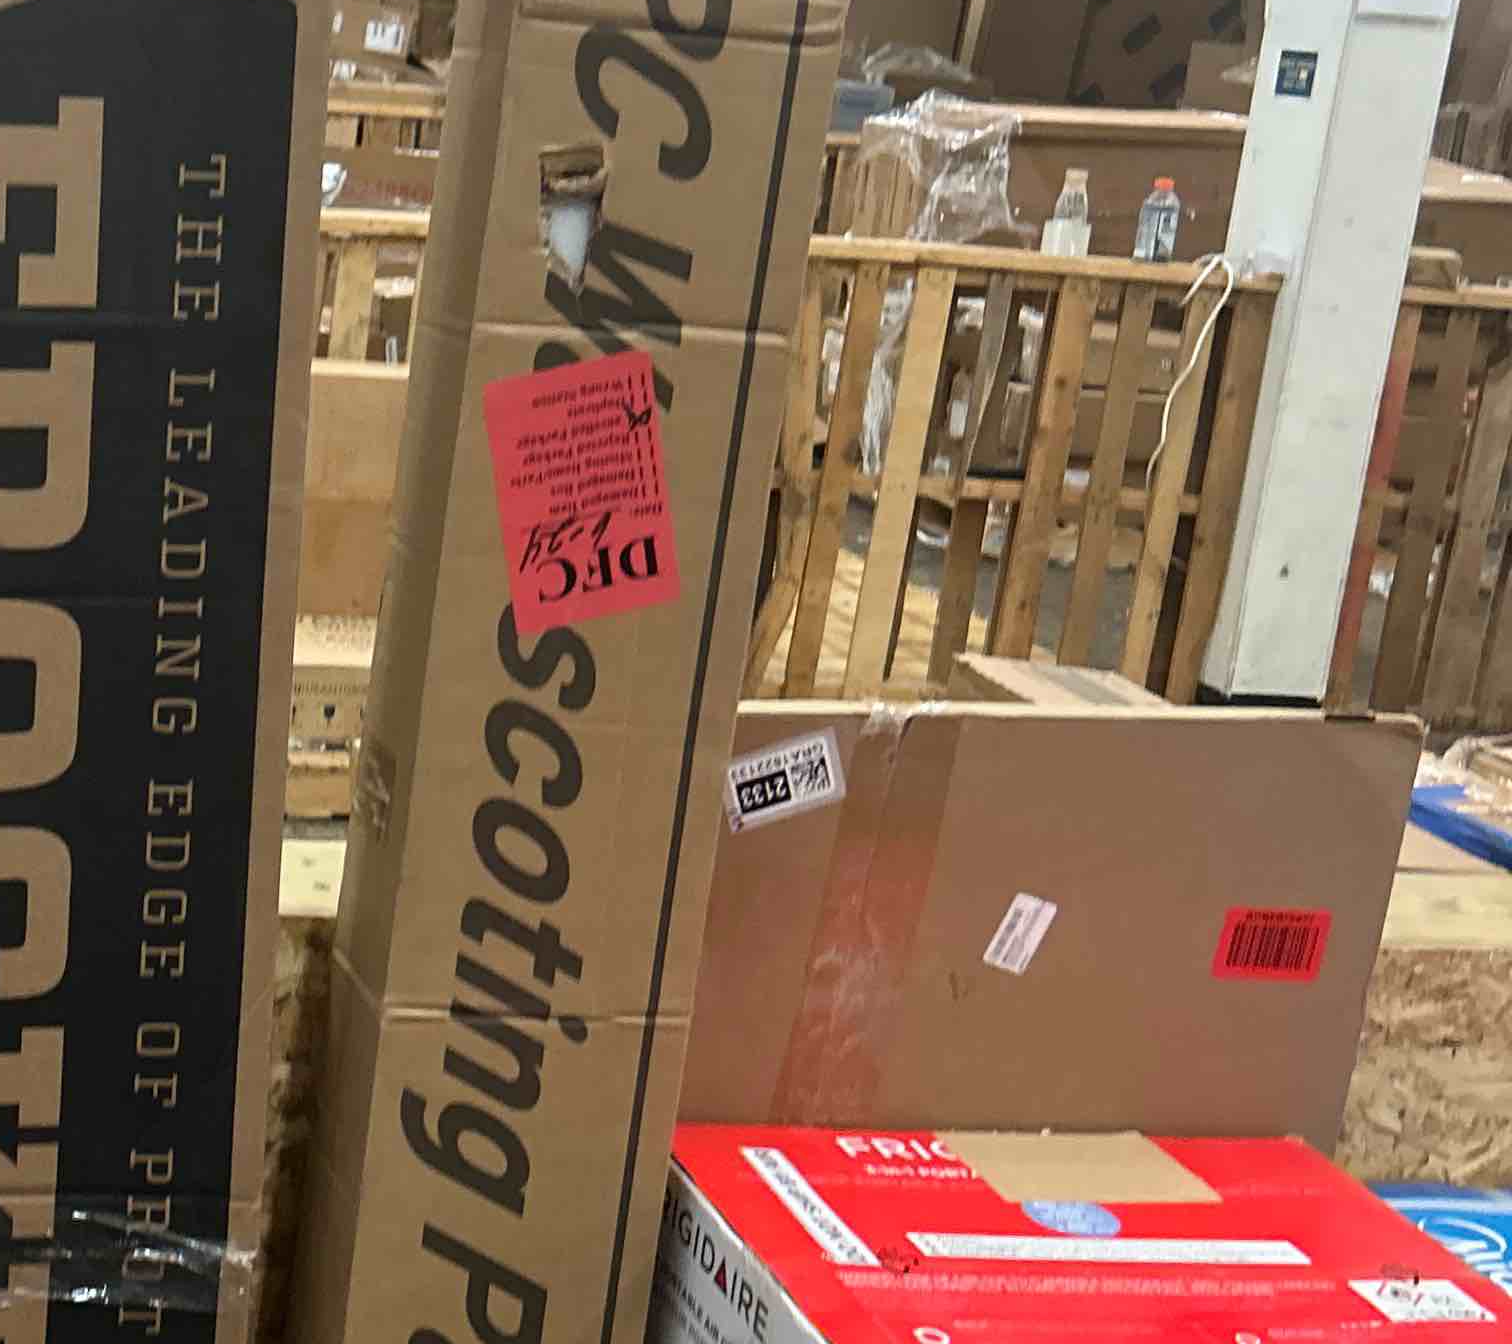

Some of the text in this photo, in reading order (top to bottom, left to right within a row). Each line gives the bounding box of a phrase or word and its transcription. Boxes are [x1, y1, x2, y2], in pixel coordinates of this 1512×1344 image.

[172, 153, 227, 322] THE
[151, 367, 217, 737] LEADING
[535, 535, 660, 605] DFC
[400, 218, 693, 1218] Wscoting
[138, 777, 194, 981] EDGE
[133, 1022, 183, 1109] OF
[663, 1187, 769, 1344] IGIDAIRE
